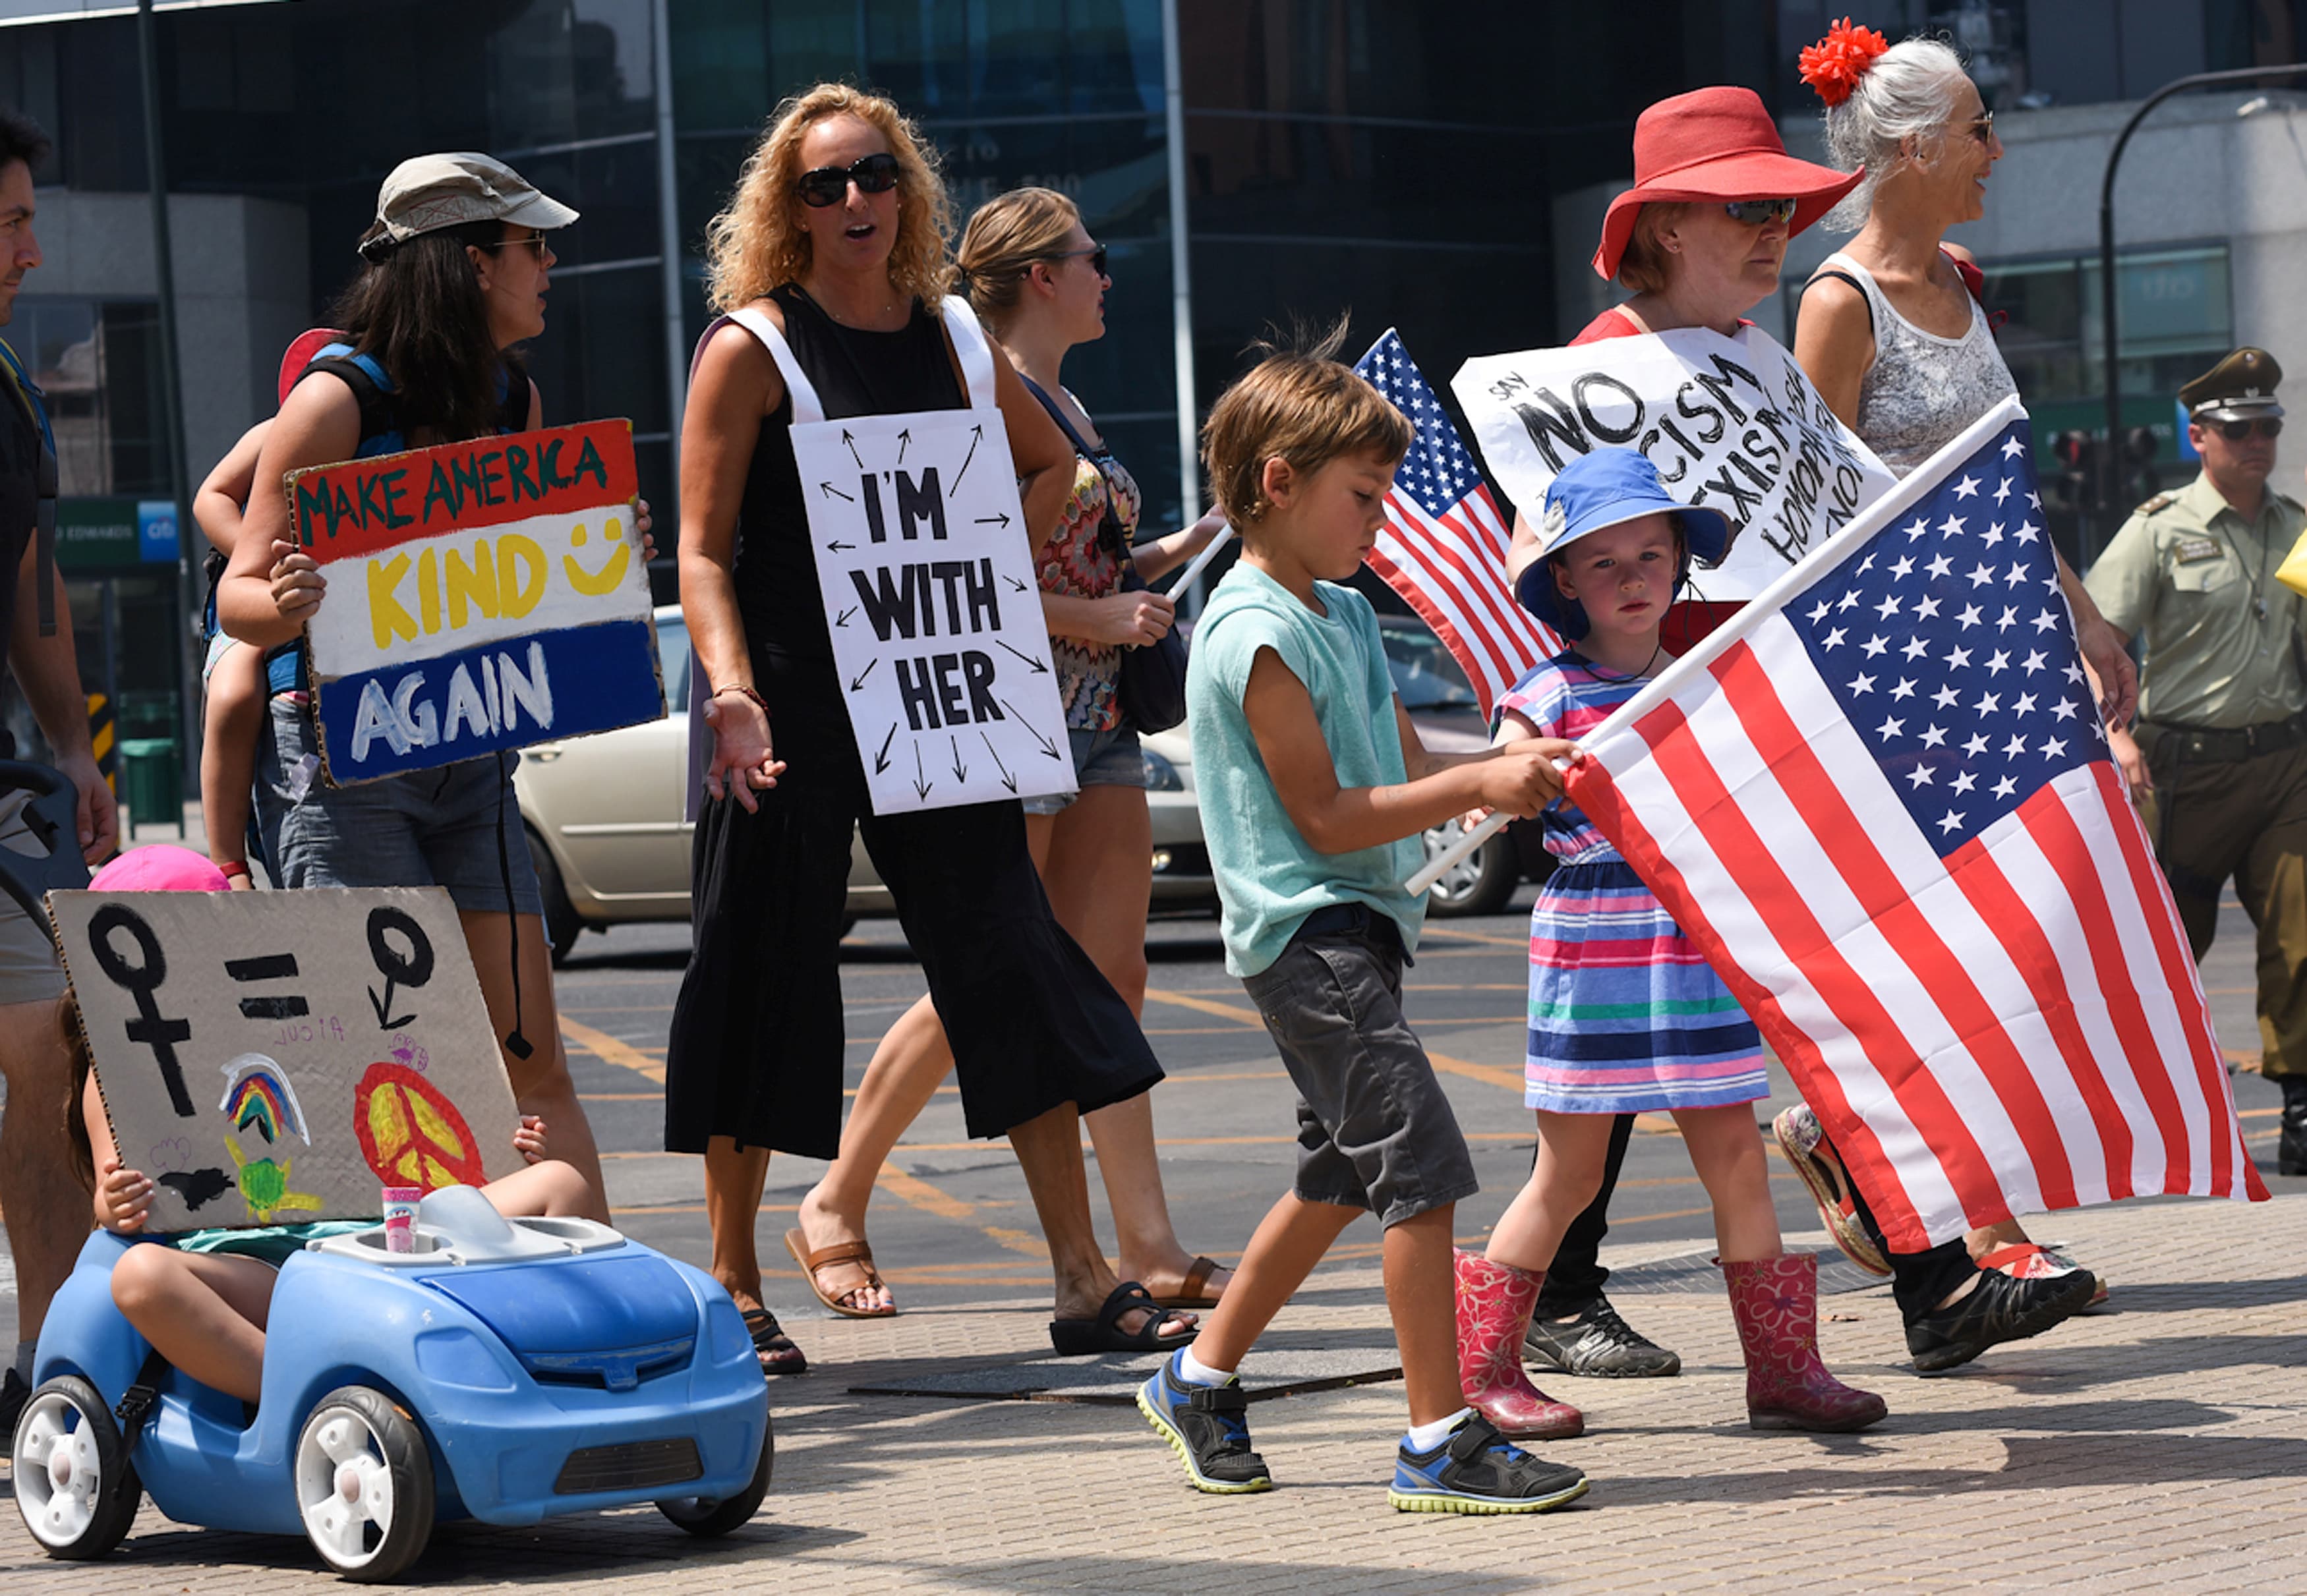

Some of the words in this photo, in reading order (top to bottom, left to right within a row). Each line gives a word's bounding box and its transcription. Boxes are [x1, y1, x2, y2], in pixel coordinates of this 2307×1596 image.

[1488, 371, 1529, 401] SAY
[1511, 372, 1646, 476] NO
[1639, 353, 1763, 483] CISM
[296, 468, 415, 547] MAKE
[423, 436, 608, 525] AMERICA
[861, 467, 948, 543] I'M
[1688, 385, 1792, 571] XISM
[67, 525, 133, 540] EDWARDS
[366, 534, 548, 650] KIND
[848, 557, 1002, 642] WITH
[351, 641, 554, 762] AGAIN
[894, 650, 1006, 730] HER
